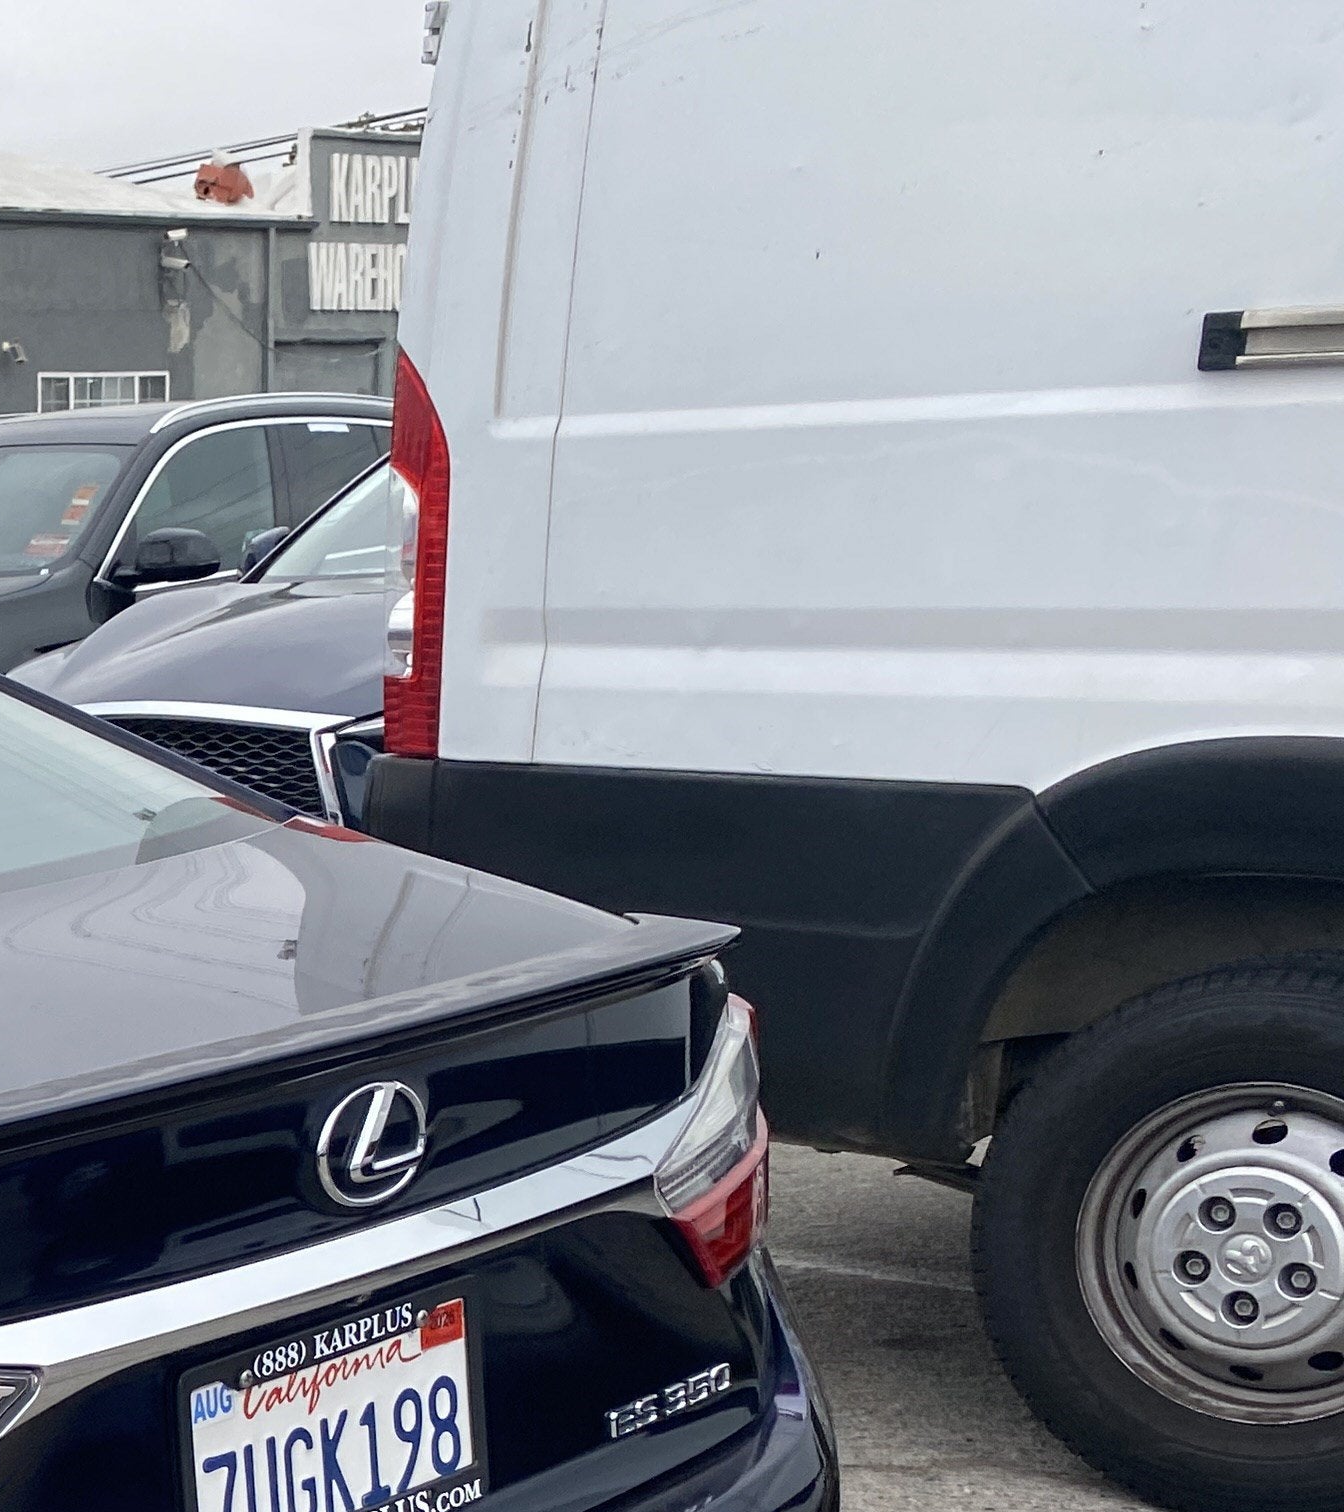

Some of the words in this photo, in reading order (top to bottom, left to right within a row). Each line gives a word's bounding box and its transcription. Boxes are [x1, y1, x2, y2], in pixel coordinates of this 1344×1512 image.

[253, 1340, 306, 1378] (888)
[313, 1302, 413, 1360] KARPLUS
[193, 1384, 233, 1424] AUG
[242, 1339, 422, 1420] California
[604, 1393, 658, 1438] ES
[665, 1362, 732, 1417] 350
